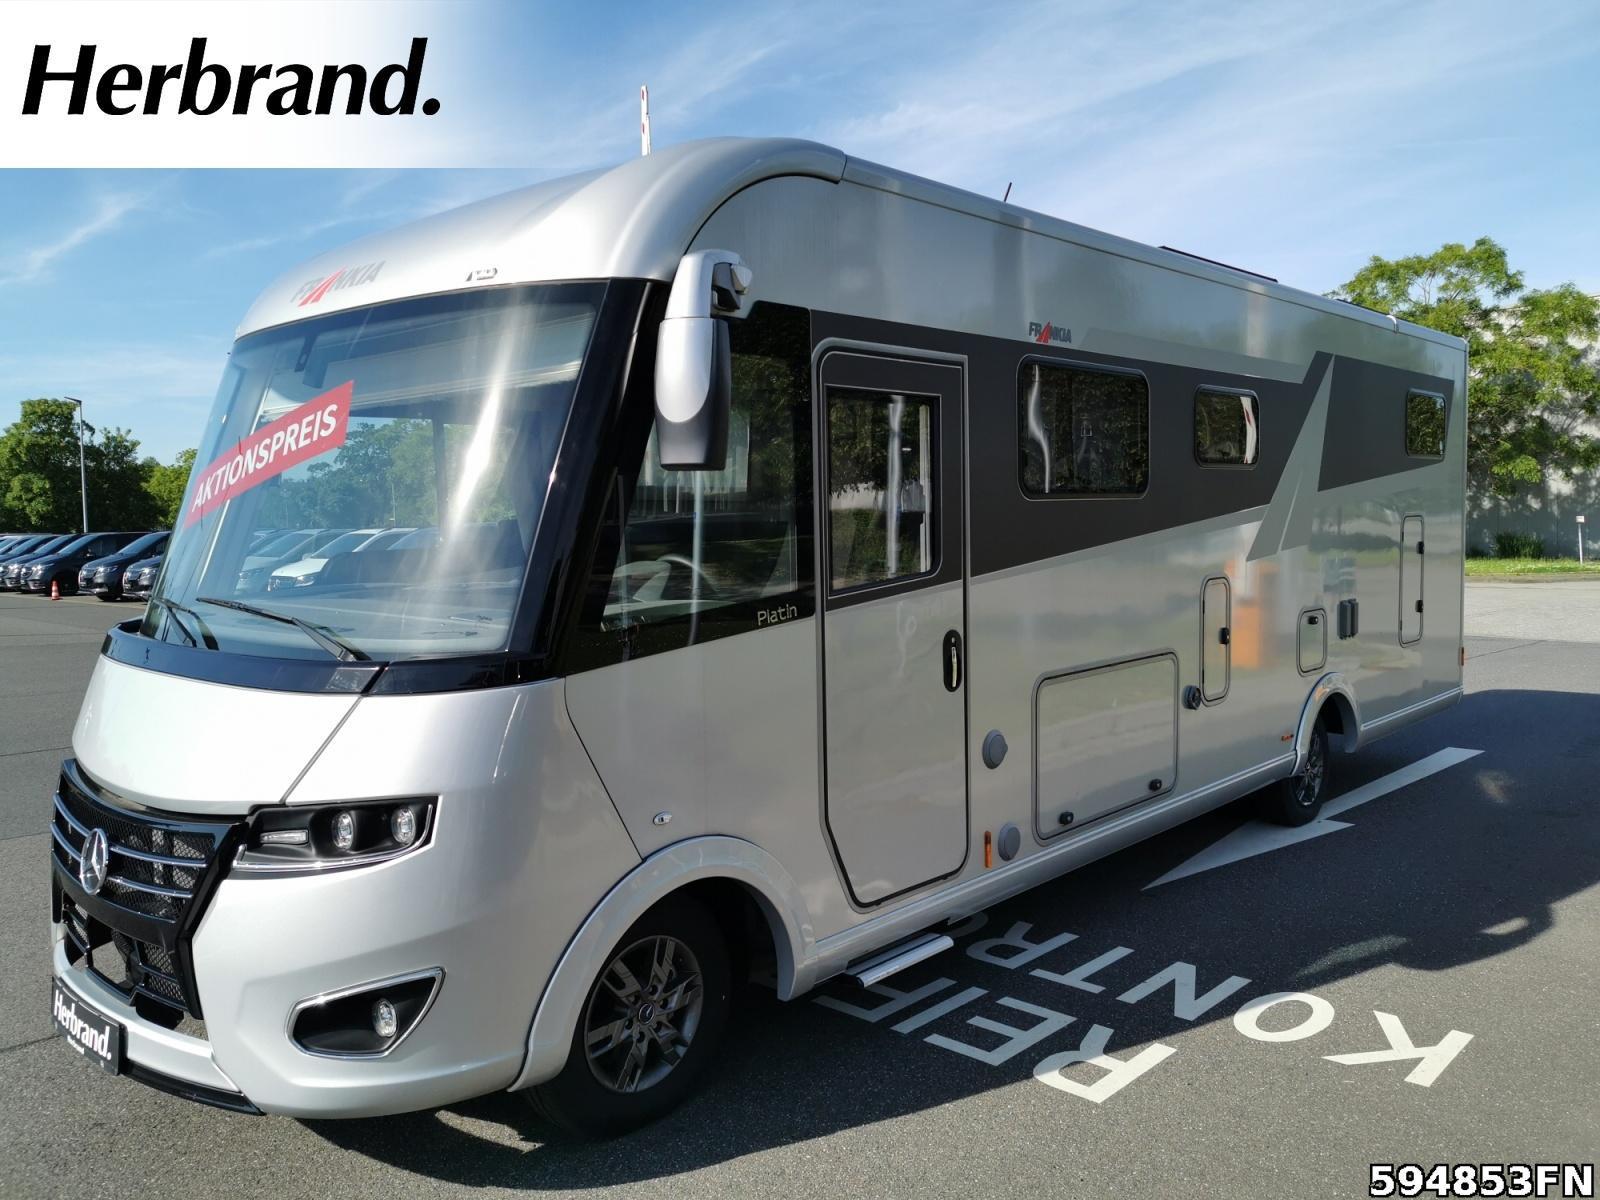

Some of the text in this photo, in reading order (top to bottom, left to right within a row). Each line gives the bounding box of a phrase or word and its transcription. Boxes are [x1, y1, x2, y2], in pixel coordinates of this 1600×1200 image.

[290, 260, 387, 307] FRANKIA
[1028, 320, 1072, 344] FRANKIA
[192, 403, 339, 513] AKTIONSPREIS
[757, 603, 798, 626] Platin
[53, 989, 112, 1060] Herbrand.
[778, 976, 1178, 1104] REIF
